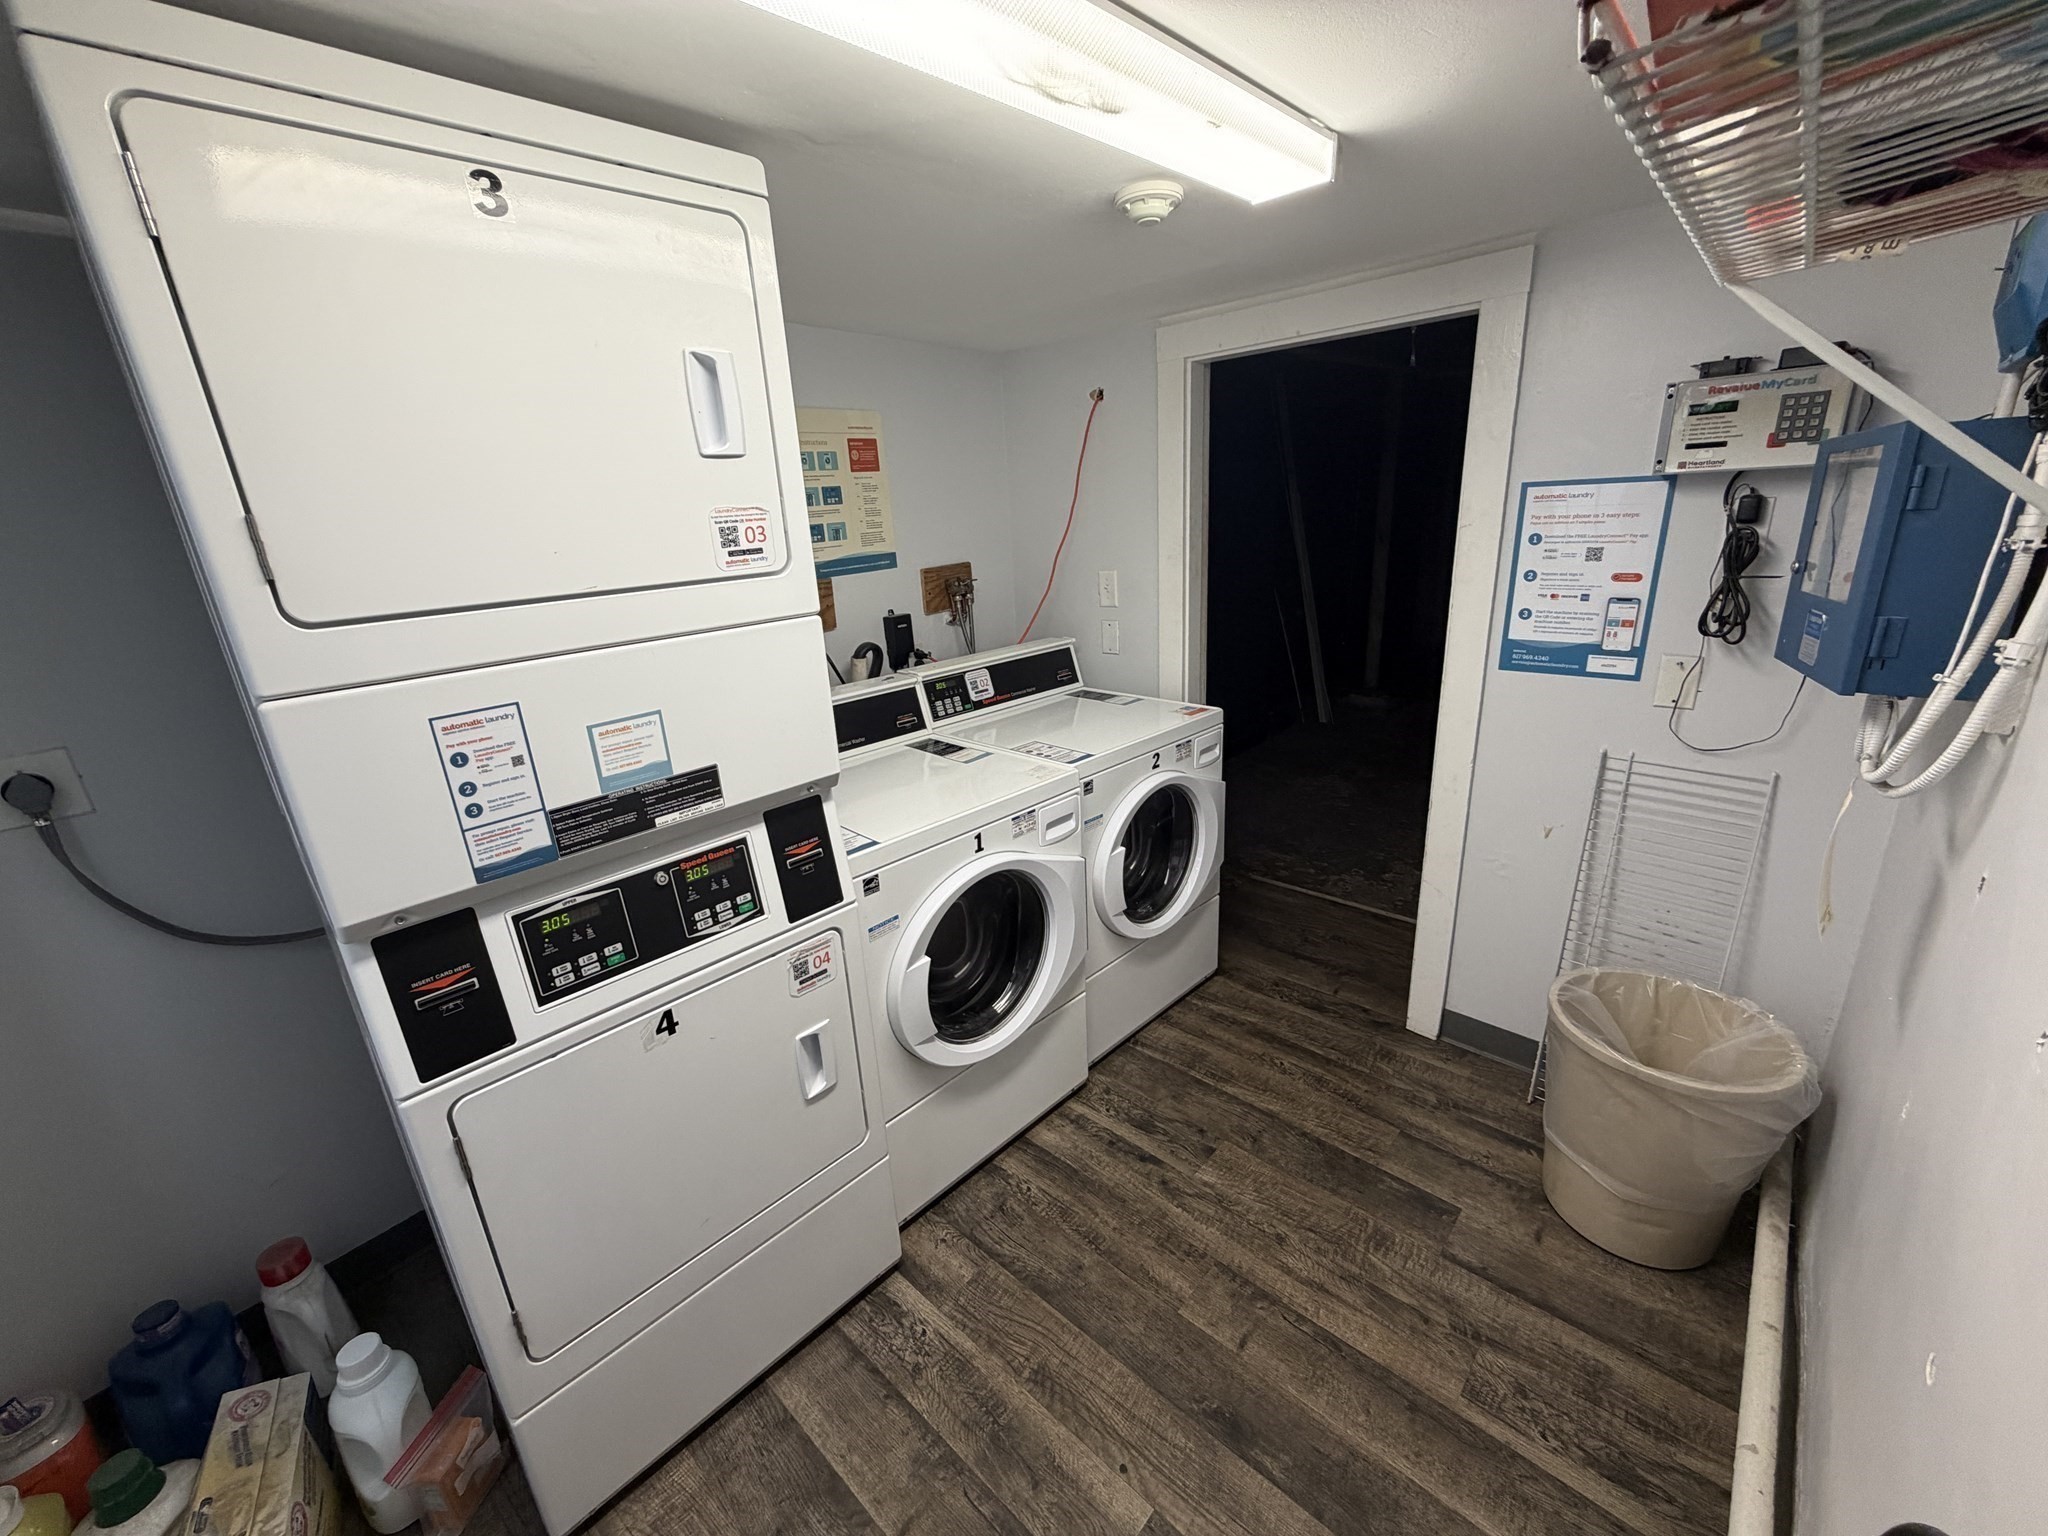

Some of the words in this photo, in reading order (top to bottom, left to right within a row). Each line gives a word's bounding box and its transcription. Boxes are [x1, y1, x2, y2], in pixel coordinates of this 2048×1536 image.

[468, 168, 509, 217] 3
[744, 525, 767, 544] 03
[1527, 572, 1534, 580] 2
[1522, 610, 1528, 618] 3
[979, 678, 990, 688] 02
[441, 718, 485, 732] automatic
[485, 713, 515, 723] laundry
[598, 725, 632, 737] automatic
[632, 719, 657, 729] laundry
[456, 756, 463, 765] 1
[1151, 752, 1161, 770] 2
[463, 785, 473, 794] 2
[470, 806, 478, 815] 3
[974, 832, 985, 854] 1
[680, 855, 708, 870] Speed
[708, 847, 735, 860] Queen
[562, 898, 577, 907] UPPER
[542, 912, 571, 934] 3.05
[718, 921, 732, 930] LOWER
[813, 951, 831, 969] 04
[411, 976, 434, 989] INSERT
[435, 969, 454, 980] CARD
[454, 962, 471, 973] HERE
[656, 1008, 679, 1037] 4
